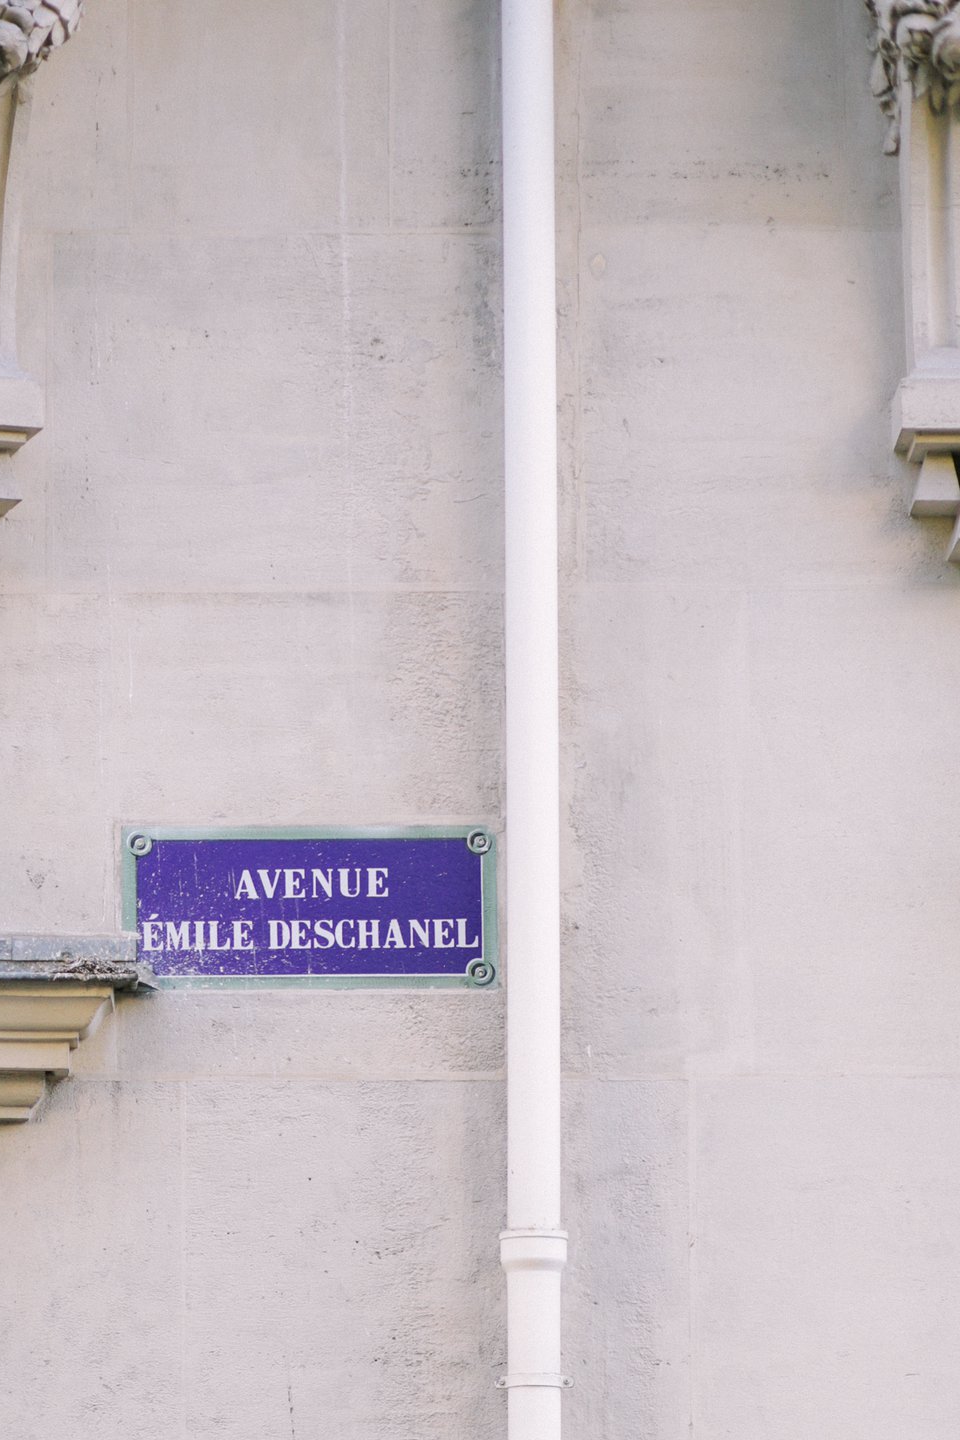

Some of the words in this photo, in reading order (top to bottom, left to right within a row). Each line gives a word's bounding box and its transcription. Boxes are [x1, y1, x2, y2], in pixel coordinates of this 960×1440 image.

[234, 867, 389, 899] AVENUE
[142, 913, 254, 951] ÉMILE
[268, 918, 479, 950] DESCHANEL
